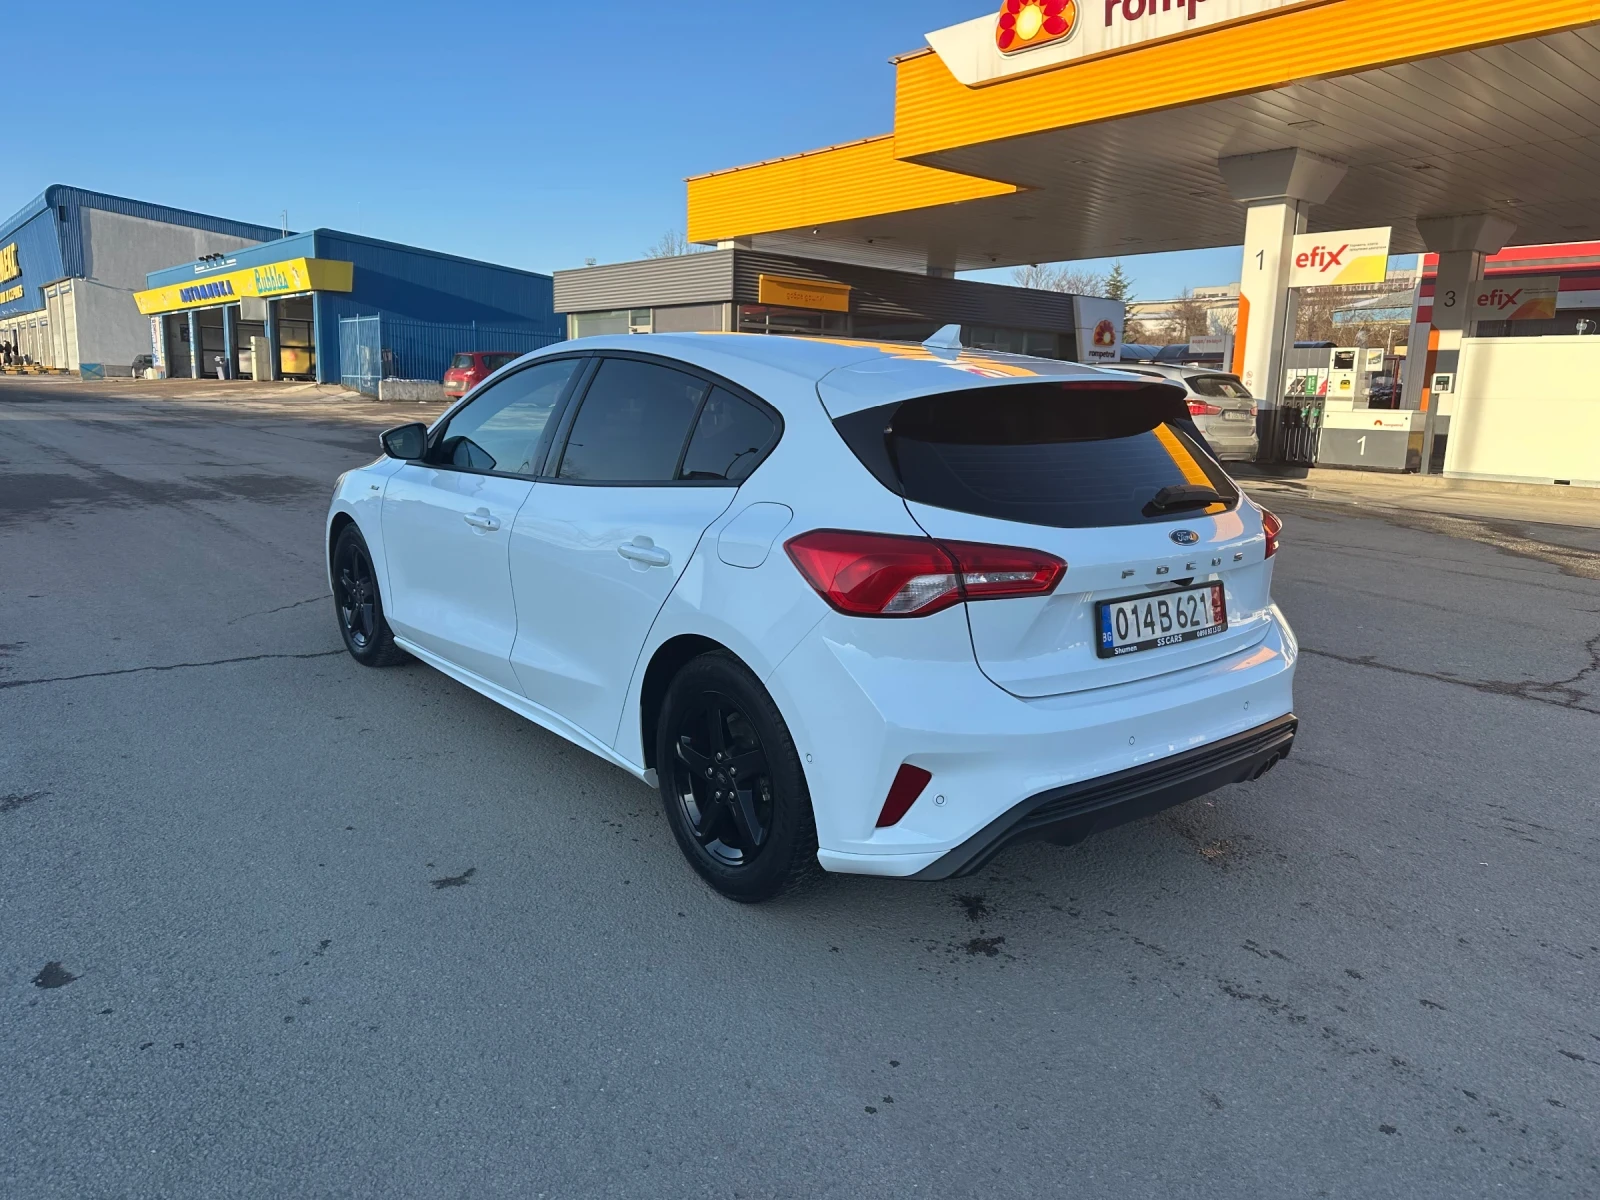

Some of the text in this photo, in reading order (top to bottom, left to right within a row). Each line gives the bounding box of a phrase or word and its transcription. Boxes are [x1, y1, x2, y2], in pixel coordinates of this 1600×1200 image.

[1255, 249, 1264, 271] 1
[1295, 243, 1349, 272] efix
[1443, 290, 1456, 307] 3
[1476, 288, 1523, 310] efix
[1088, 350, 1116, 359] rompetrol
[1356, 435, 1367, 456] 1
[1121, 552, 1243, 579] FOCUS
[1102, 632, 1112, 642] BG
[1114, 645, 1138, 655] Shumen
[1166, 634, 1182, 644] CARS
